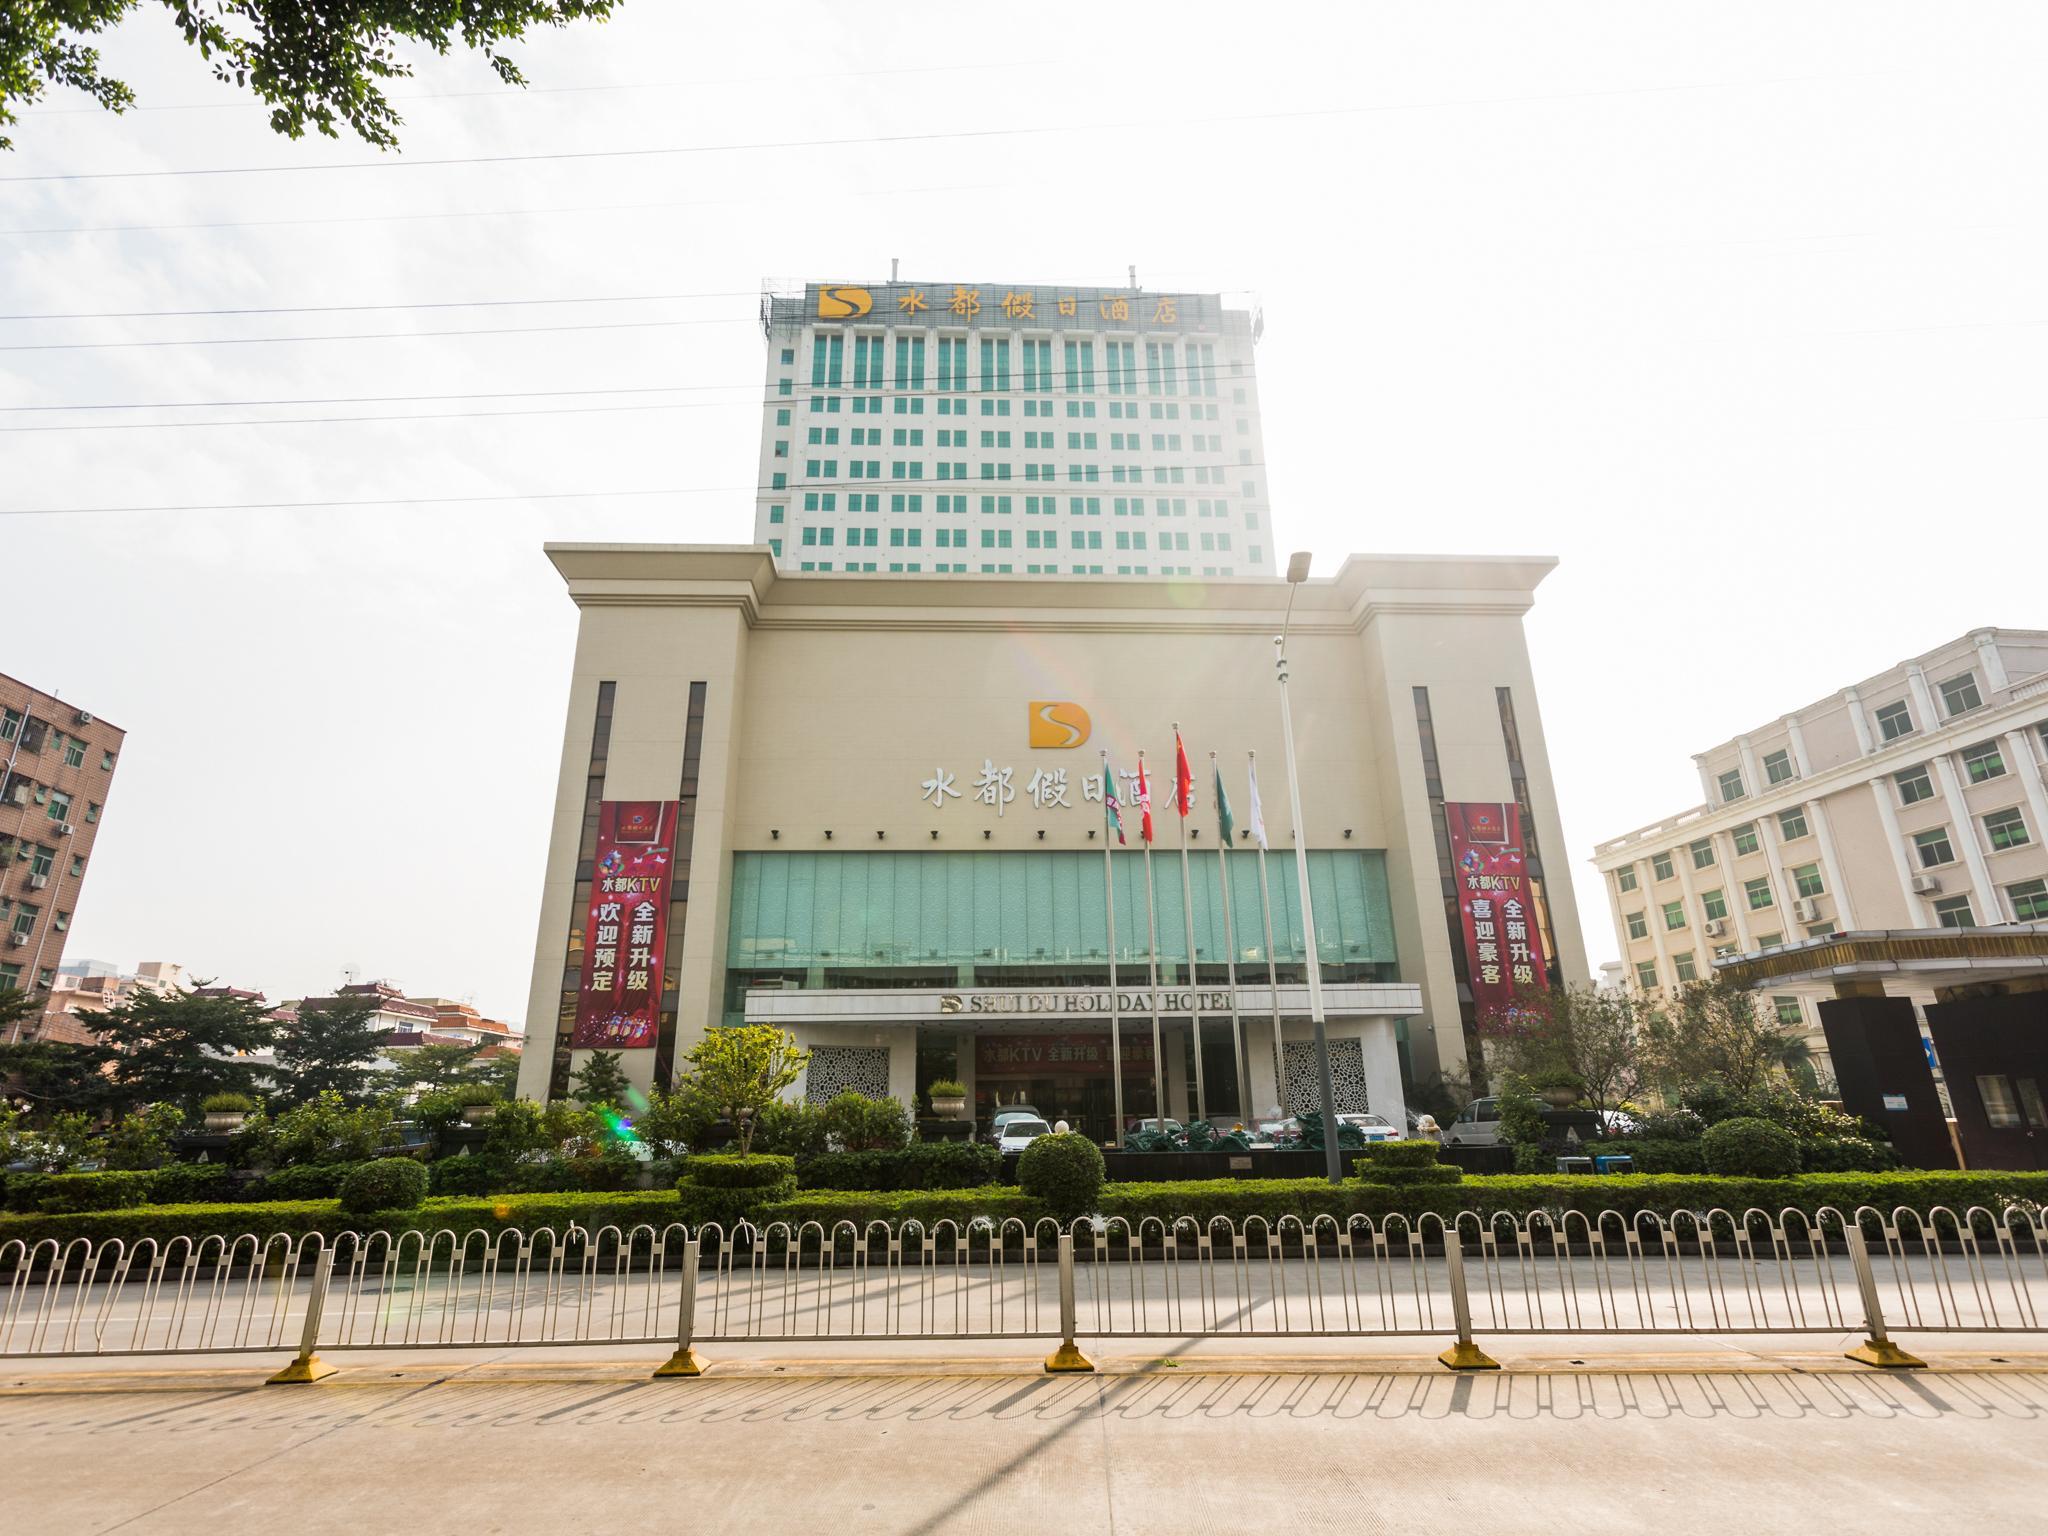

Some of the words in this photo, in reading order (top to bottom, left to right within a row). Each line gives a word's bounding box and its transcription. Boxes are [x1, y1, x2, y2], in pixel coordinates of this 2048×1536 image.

[899, 285, 1178, 324] 水都假日酒店
[602, 877, 661, 893] 水都KTV
[1467, 875, 1520, 891] 水都KTV
[591, 902, 620, 992] 欢迎预定
[626, 901, 656, 991] 全新升级
[1471, 898, 1501, 984] 喜迎豪客
[1503, 899, 1534, 984] 全新升级
[970, 995, 1022, 1013] SHUI
[1027, 994, 1058, 1013] DU
[1064, 993, 1160, 1012] HOLIDAY
[1163, 992, 1233, 1011] HOTEL
